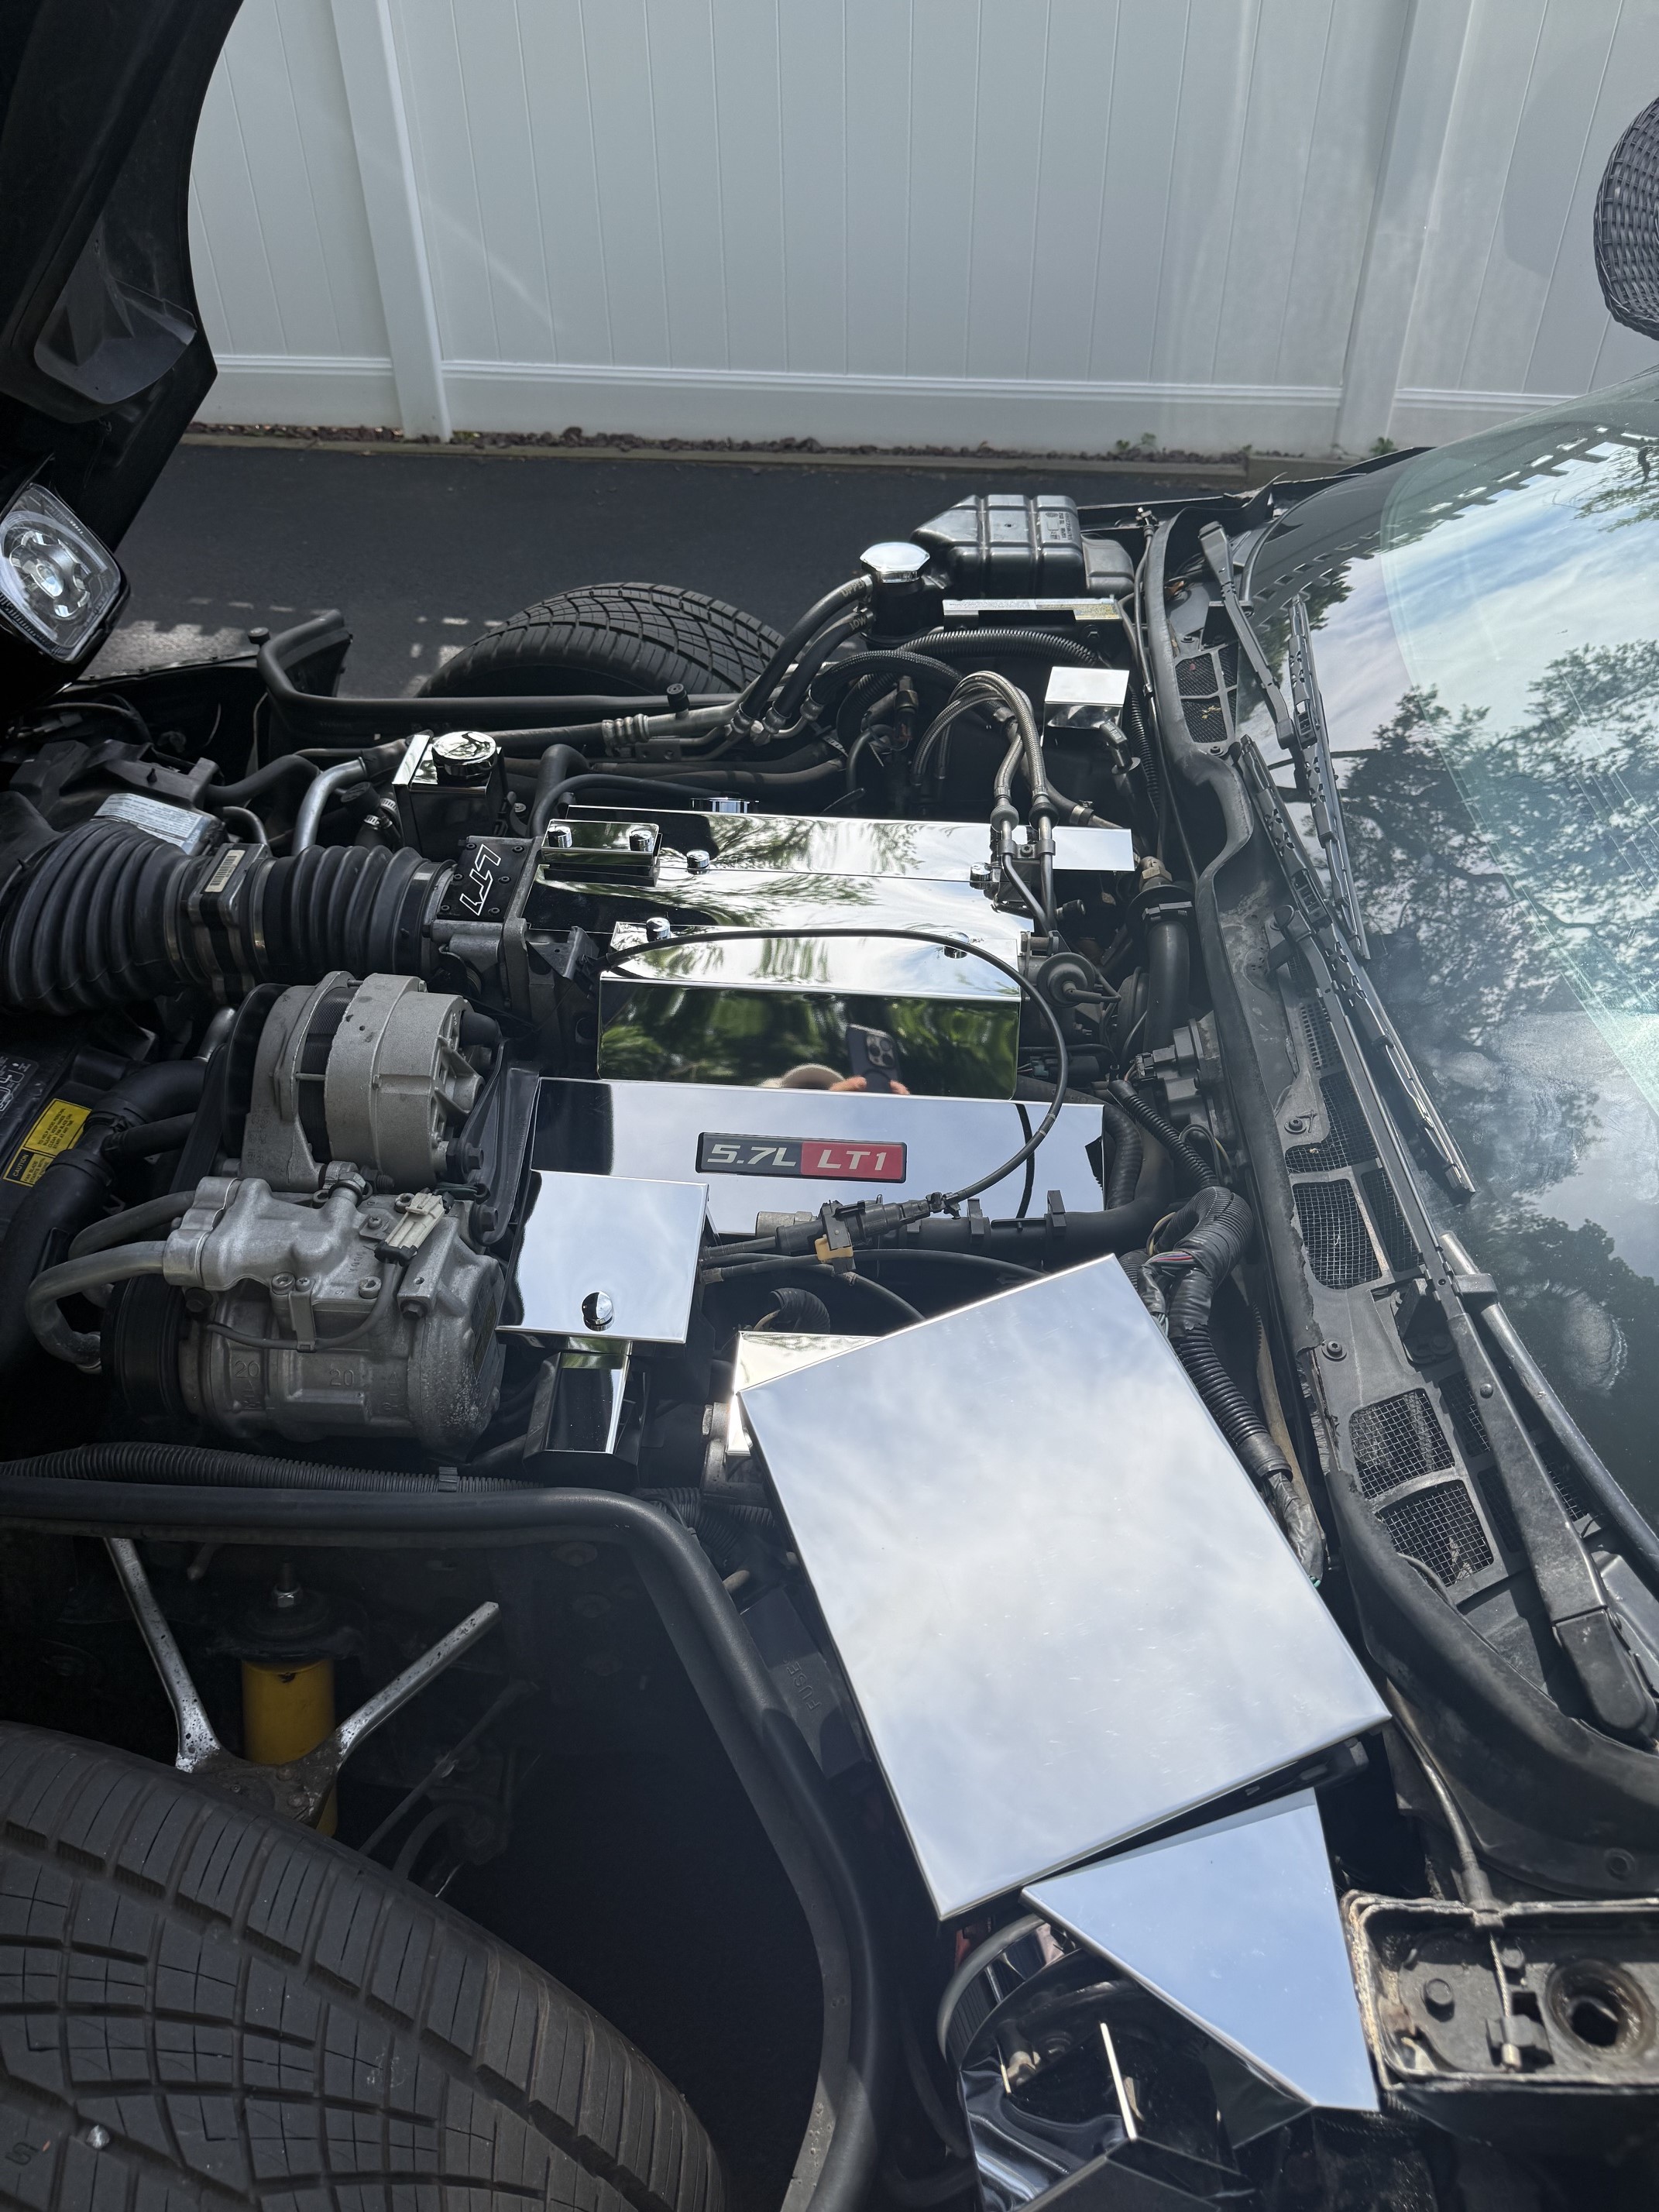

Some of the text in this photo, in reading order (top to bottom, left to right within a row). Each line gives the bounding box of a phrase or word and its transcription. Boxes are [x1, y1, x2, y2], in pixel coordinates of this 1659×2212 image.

[459, 843, 502, 916] LT1
[12, 1154, 29, 1177] CAUTION
[706, 1143, 888, 1171] 5.7L LT1
[234, 1360, 261, 1379] 20
[329, 1369, 355, 1387] 20
[783, 1651, 822, 1711] FUSES
